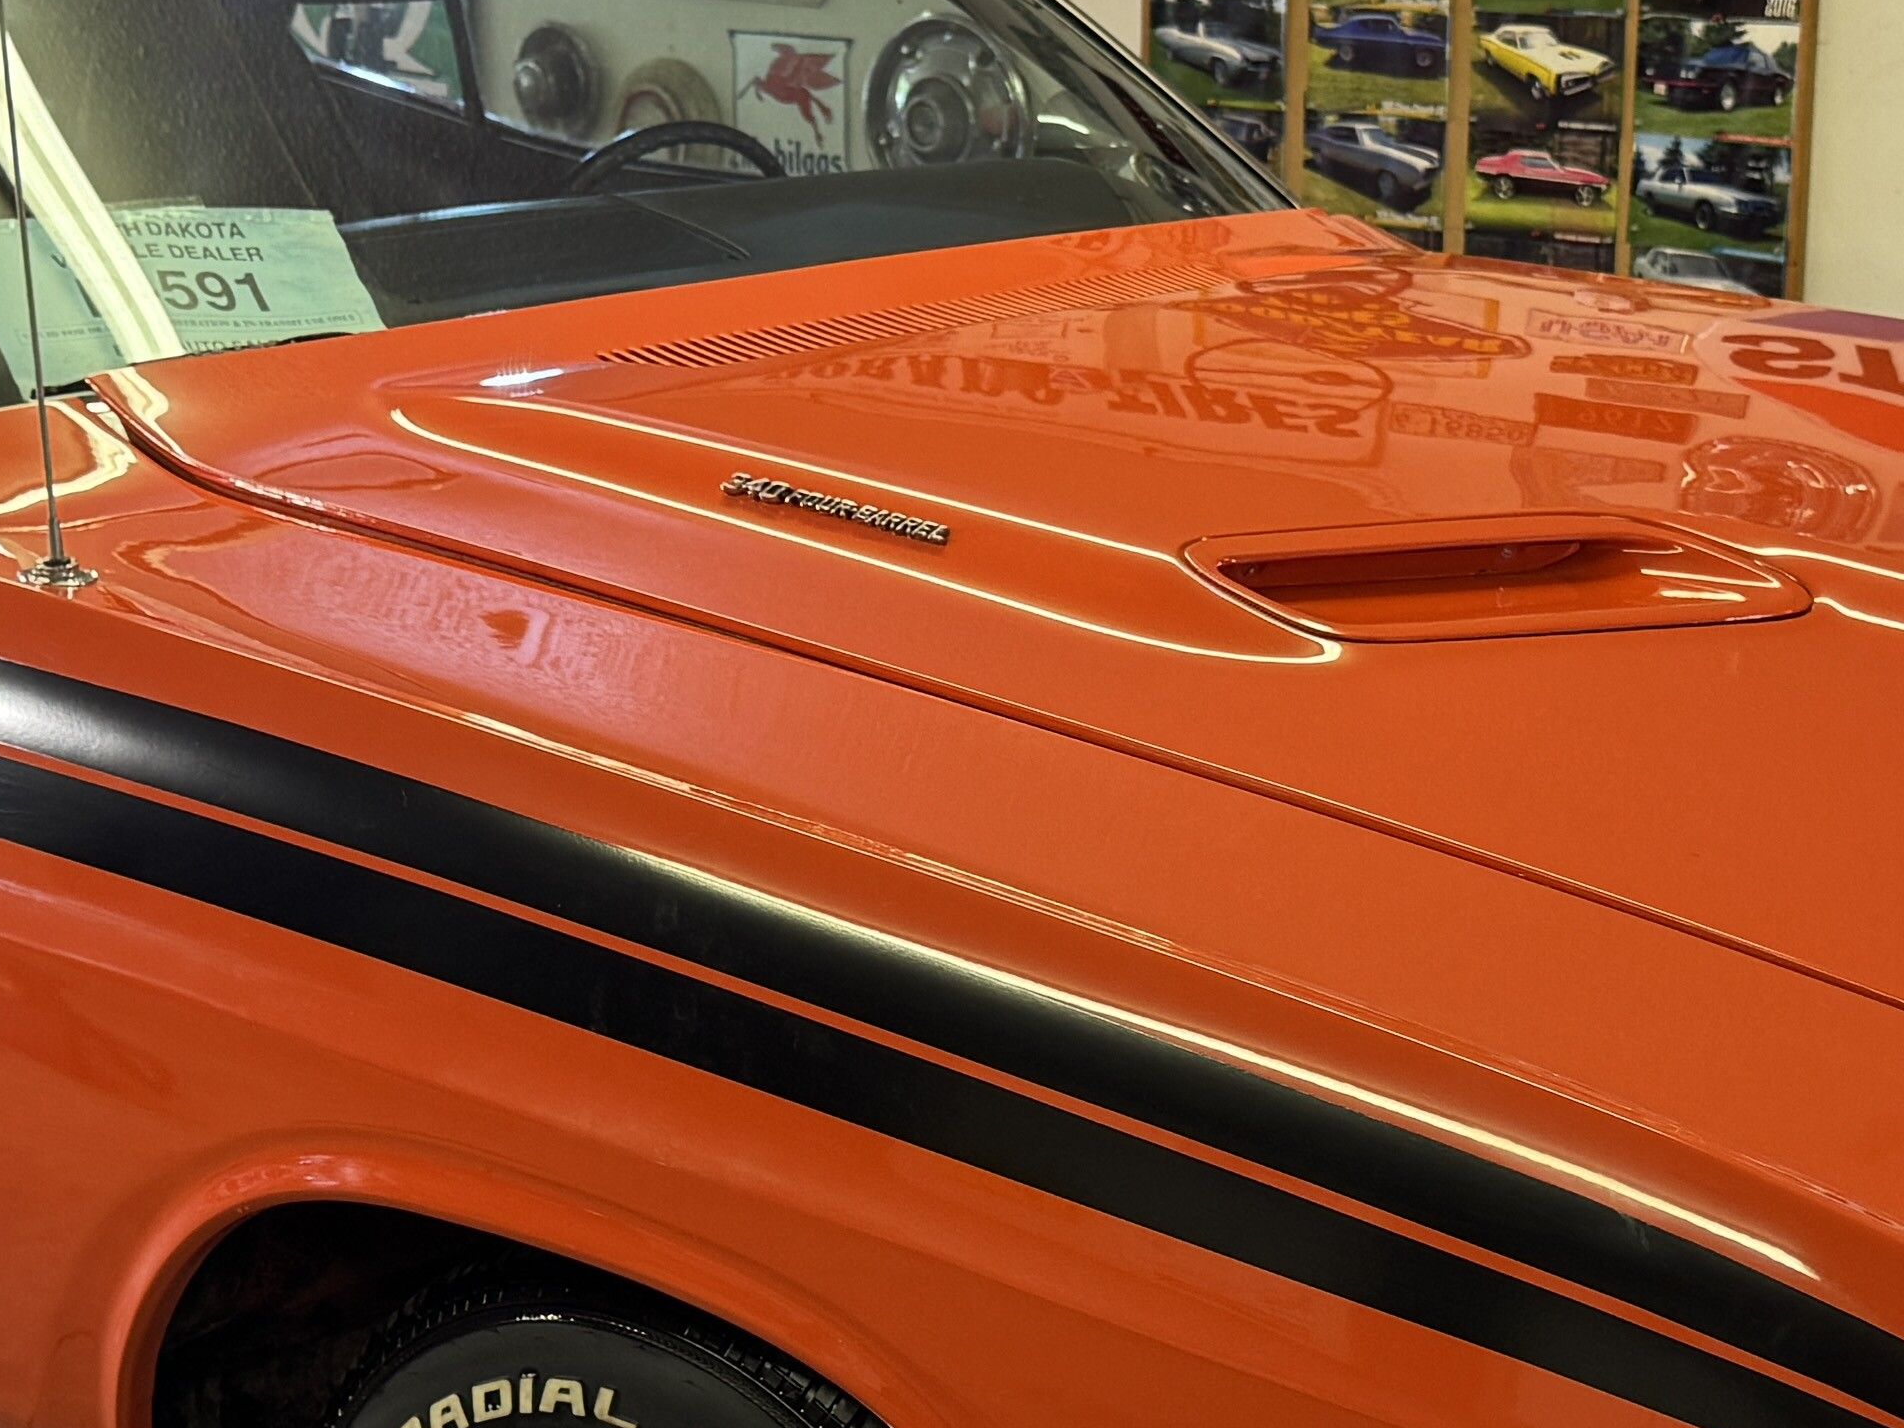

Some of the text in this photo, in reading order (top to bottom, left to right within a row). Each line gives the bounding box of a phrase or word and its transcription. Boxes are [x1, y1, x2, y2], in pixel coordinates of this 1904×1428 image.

[147, 221, 246, 240] DAKOTA
[168, 243, 265, 263] DEALER
[156, 269, 271, 313] 591
[720, 471, 790, 504] 340
